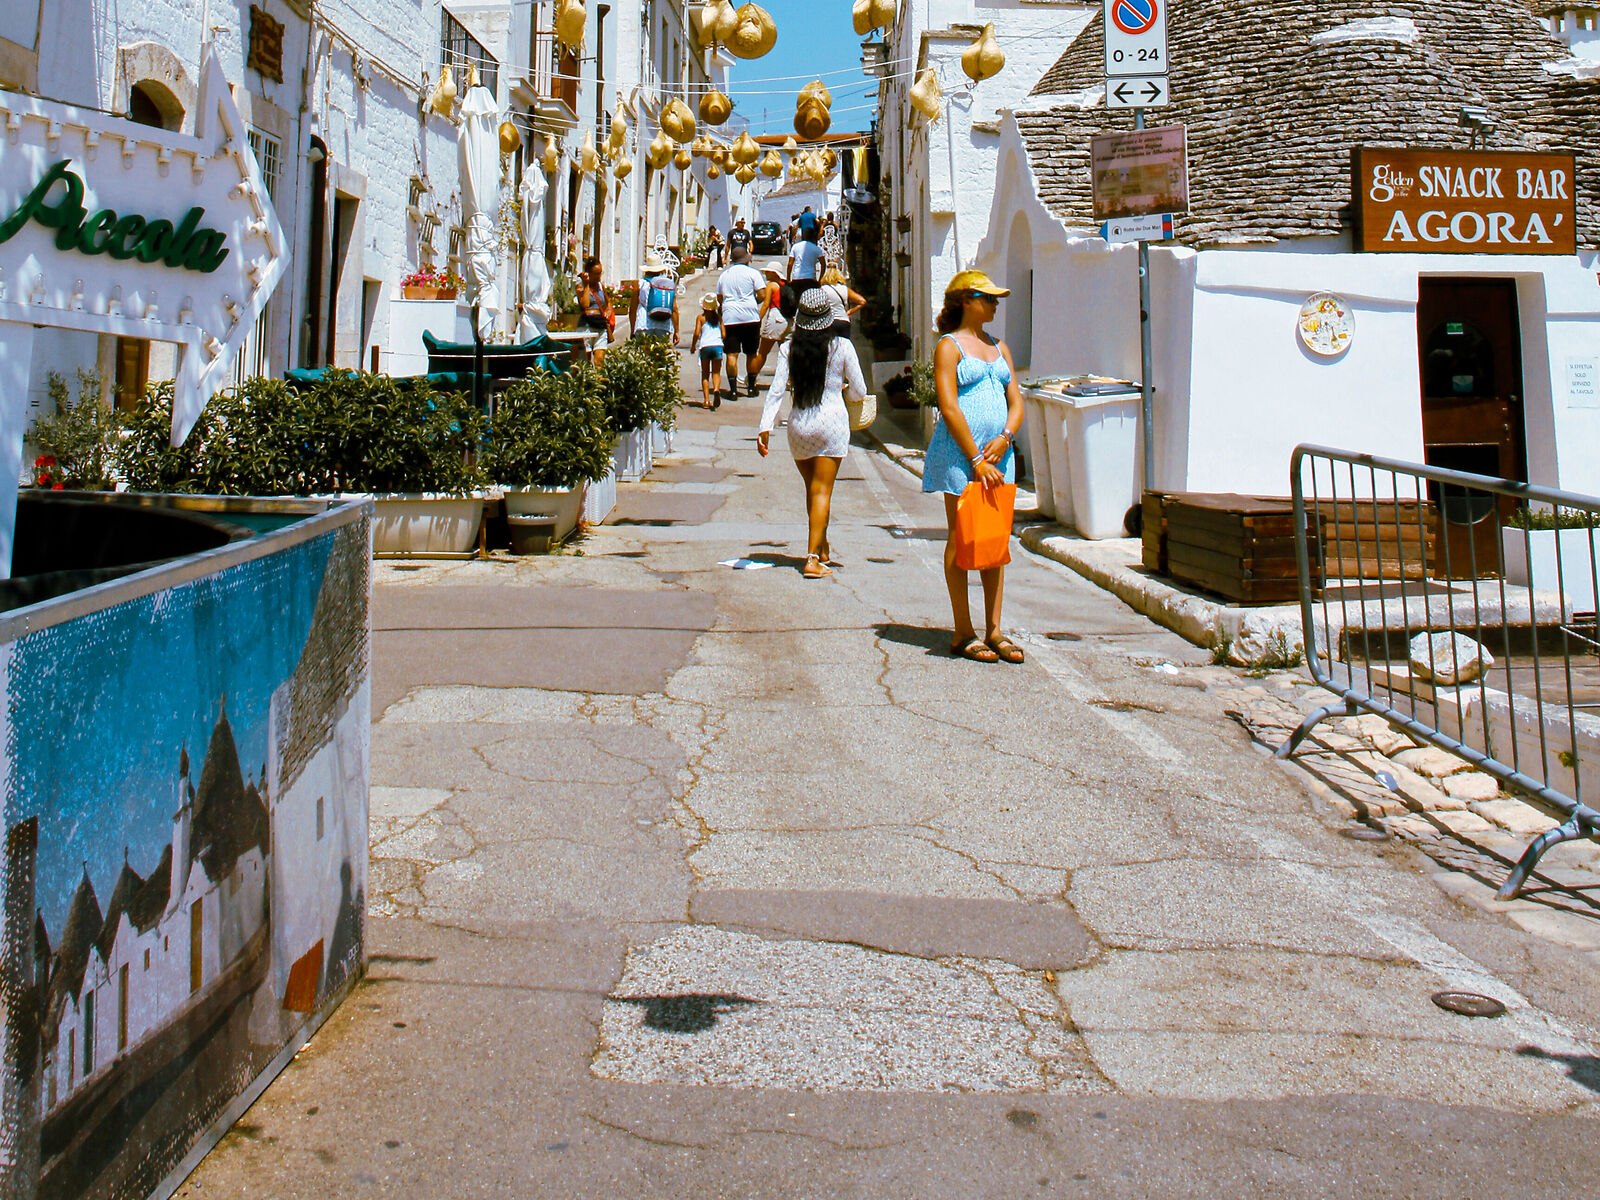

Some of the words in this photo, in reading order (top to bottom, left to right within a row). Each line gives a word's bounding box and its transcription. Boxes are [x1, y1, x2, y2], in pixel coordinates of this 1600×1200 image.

[1113, 49, 1124, 62] 0
[1137, 48, 1160, 62] 24
[1369, 163, 1414, 203] golden
[1418, 165, 1505, 198] SNACK
[1516, 168, 1569, 200] BAR
